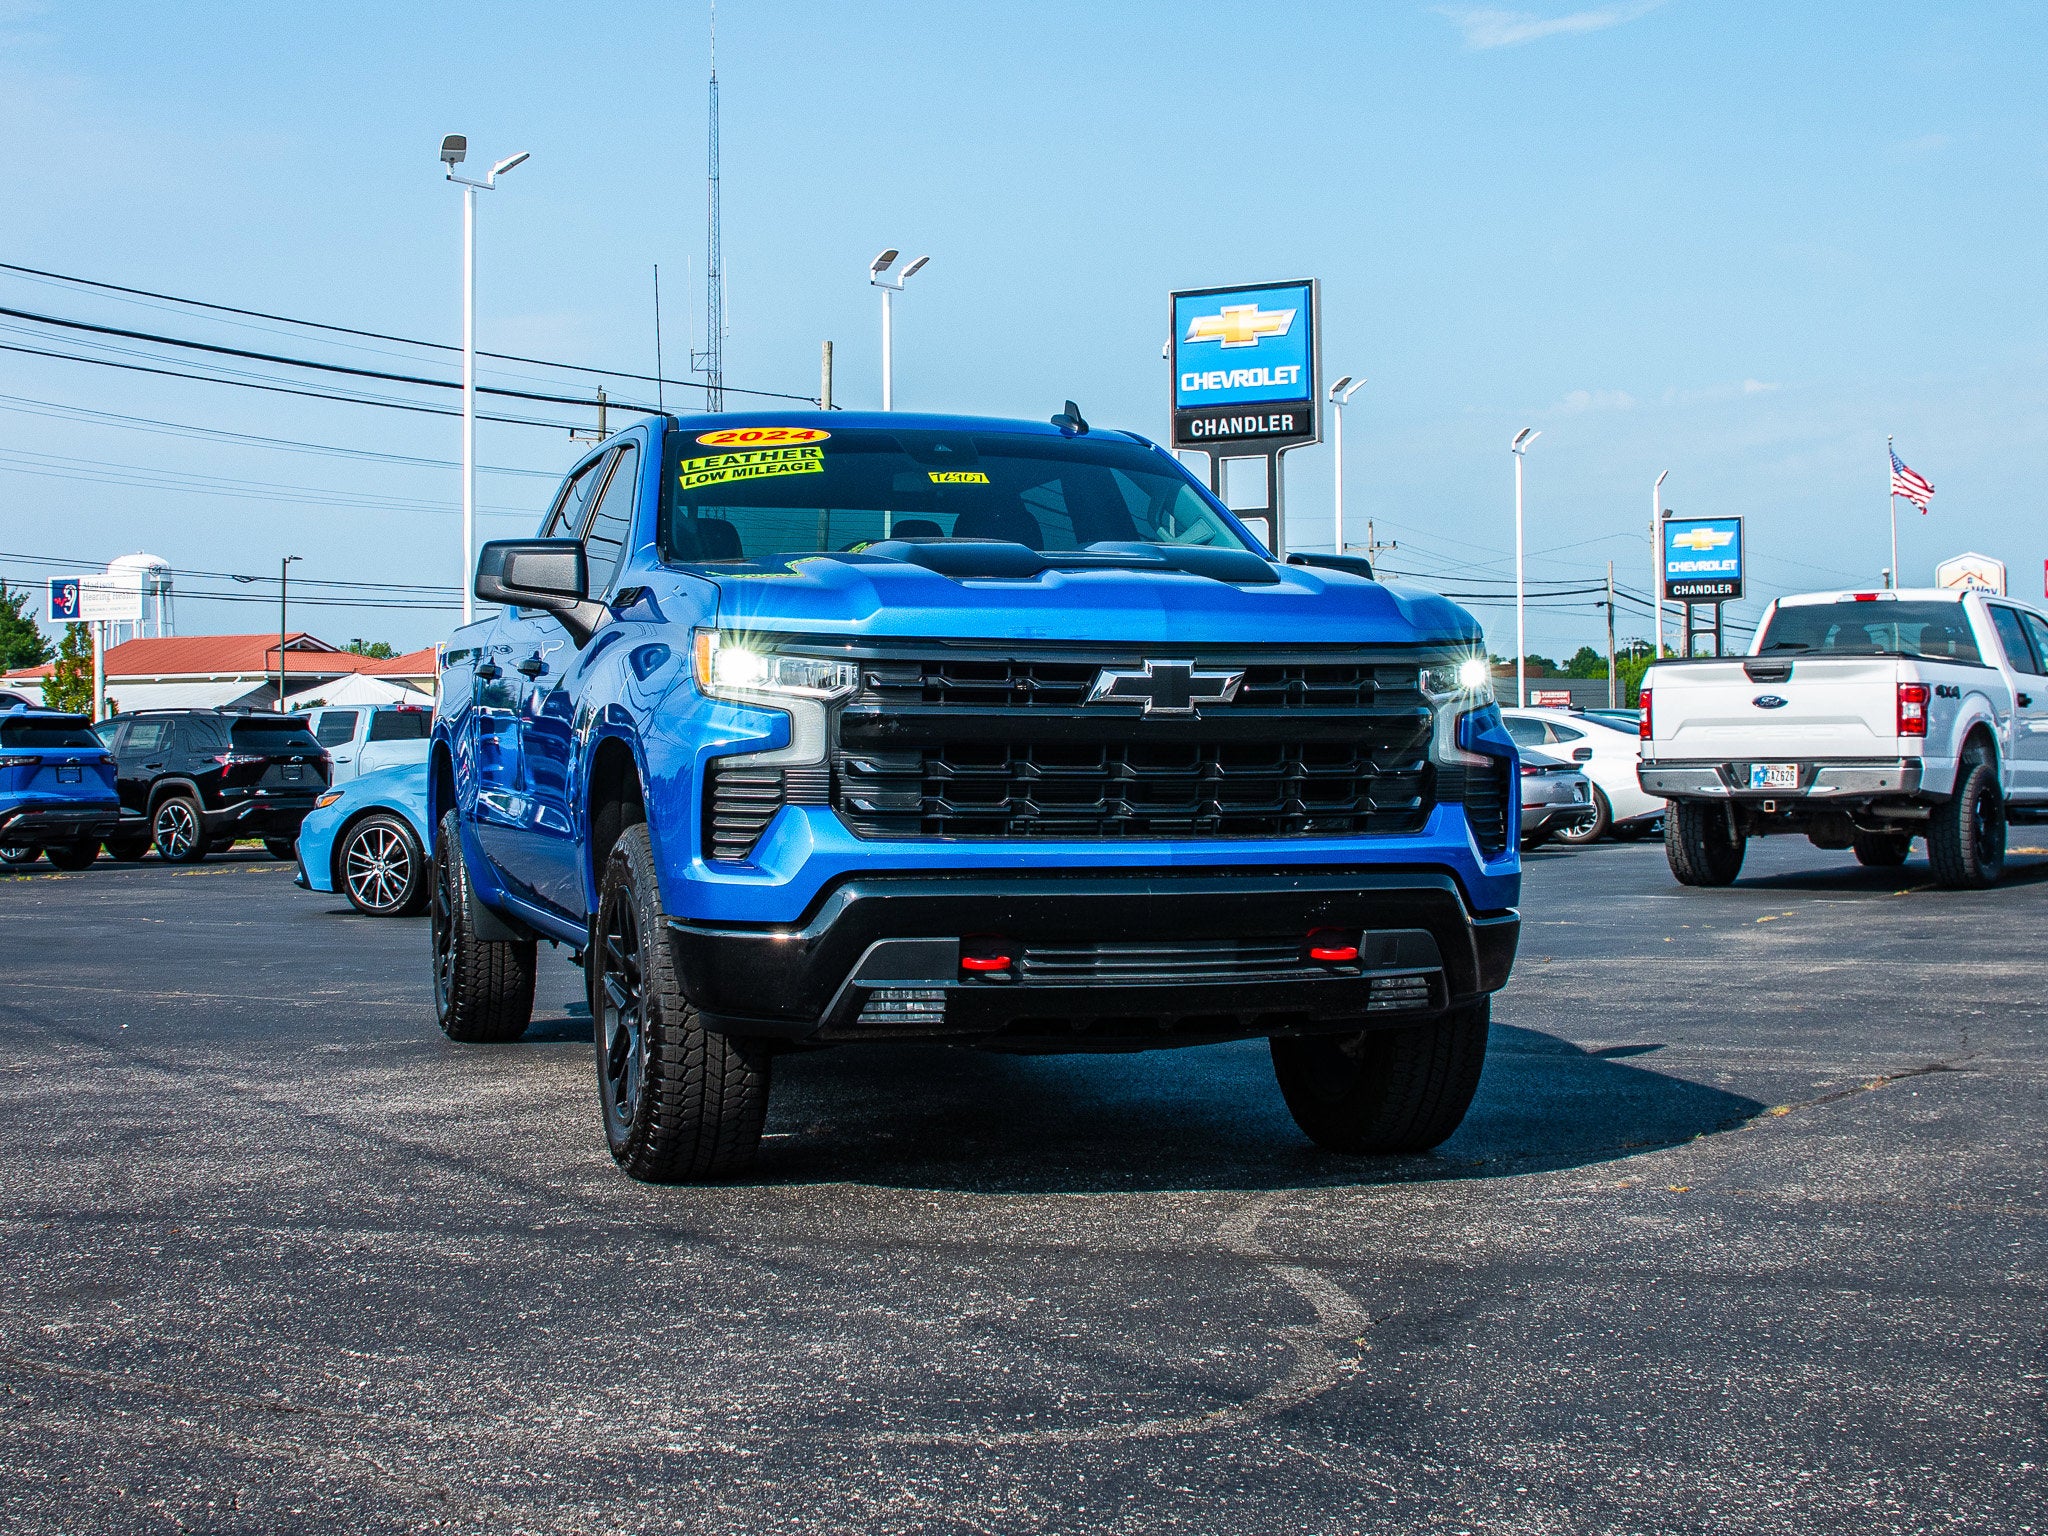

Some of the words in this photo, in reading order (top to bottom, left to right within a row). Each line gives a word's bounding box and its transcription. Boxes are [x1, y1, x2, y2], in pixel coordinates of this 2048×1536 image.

[1181, 365, 1300, 392] CHEVROLET
[1191, 414, 1294, 436] CHANDLER
[711, 430, 816, 444] 2024
[687, 448, 819, 471] LEATHER
[685, 470, 727, 486] LOW
[731, 461, 816, 478] MILEAGE
[1668, 559, 1738, 572] CHEVROLET
[1673, 584, 1732, 595] CHANDLER
